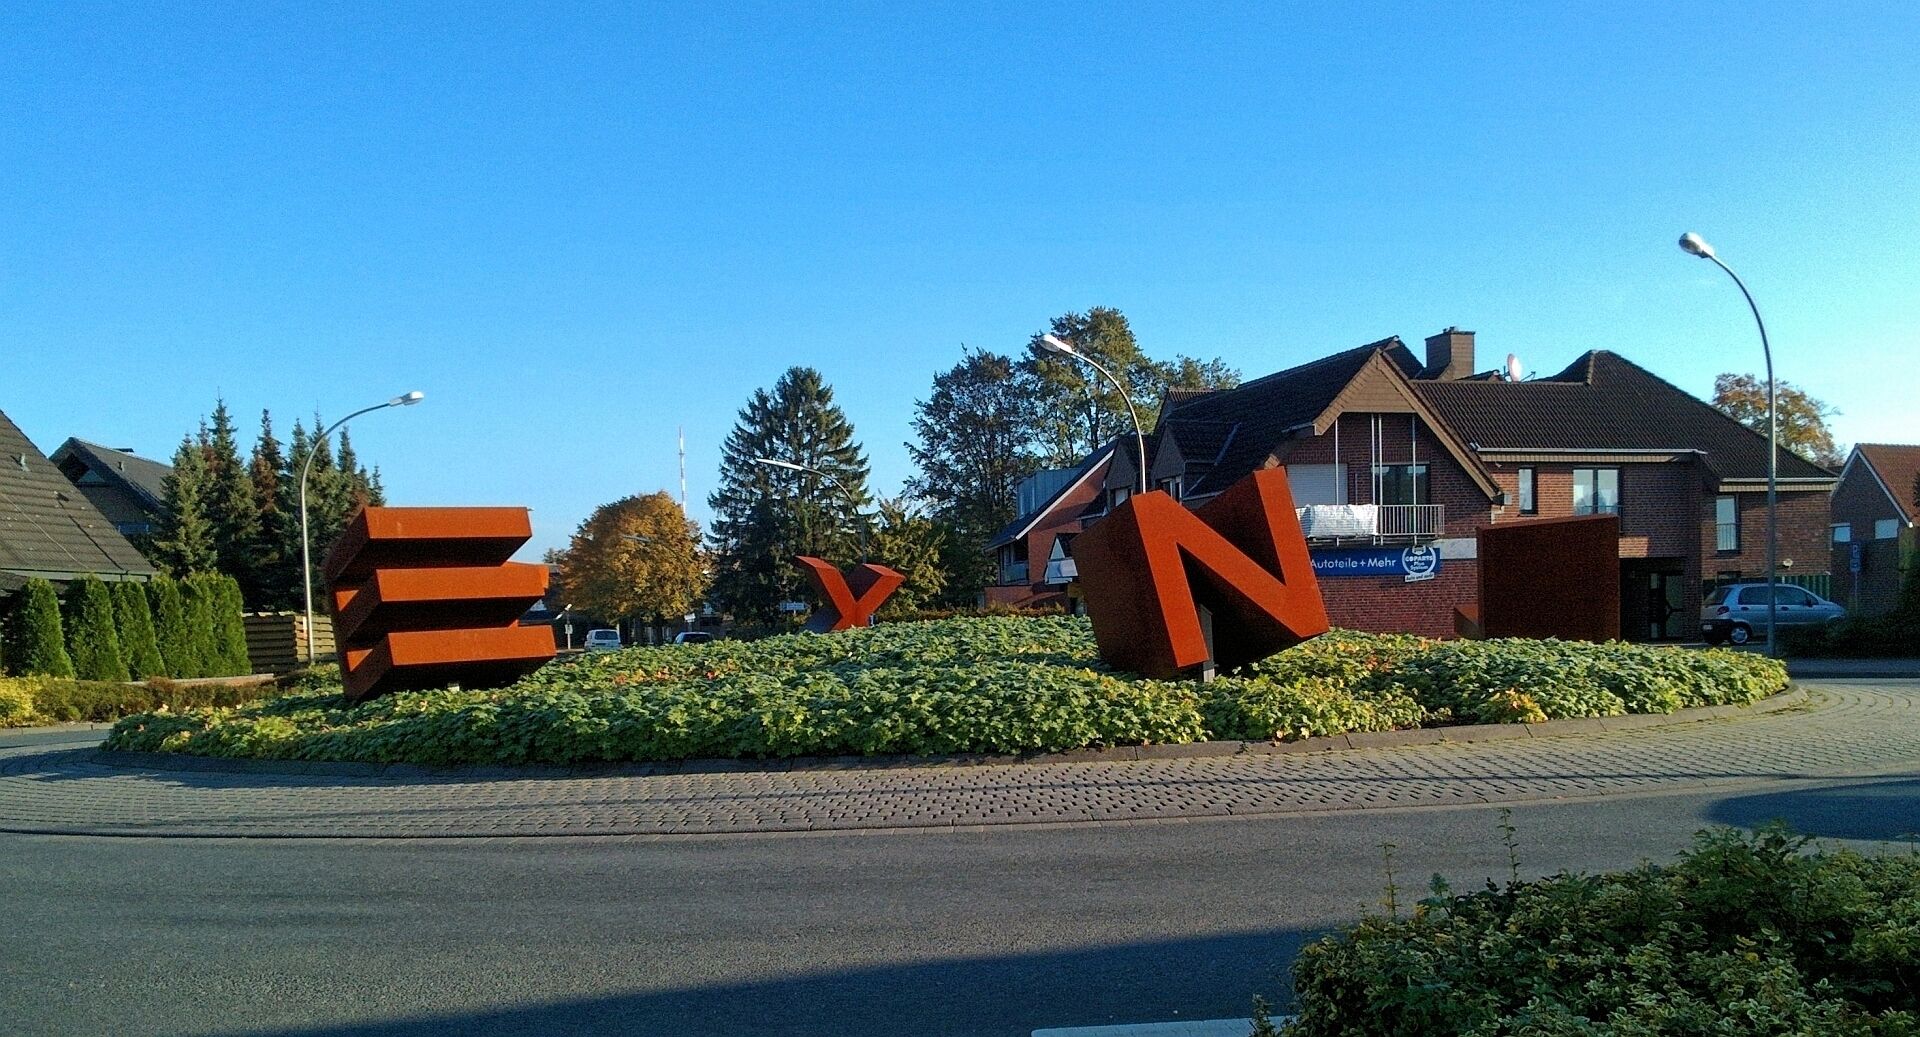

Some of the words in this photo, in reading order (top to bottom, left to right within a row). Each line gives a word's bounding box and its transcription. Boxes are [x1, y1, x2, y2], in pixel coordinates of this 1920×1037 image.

[1115, 466, 1330, 670] N
[1311, 558, 1358, 569] Autoteile
[1367, 557, 1396, 567] Mehr
